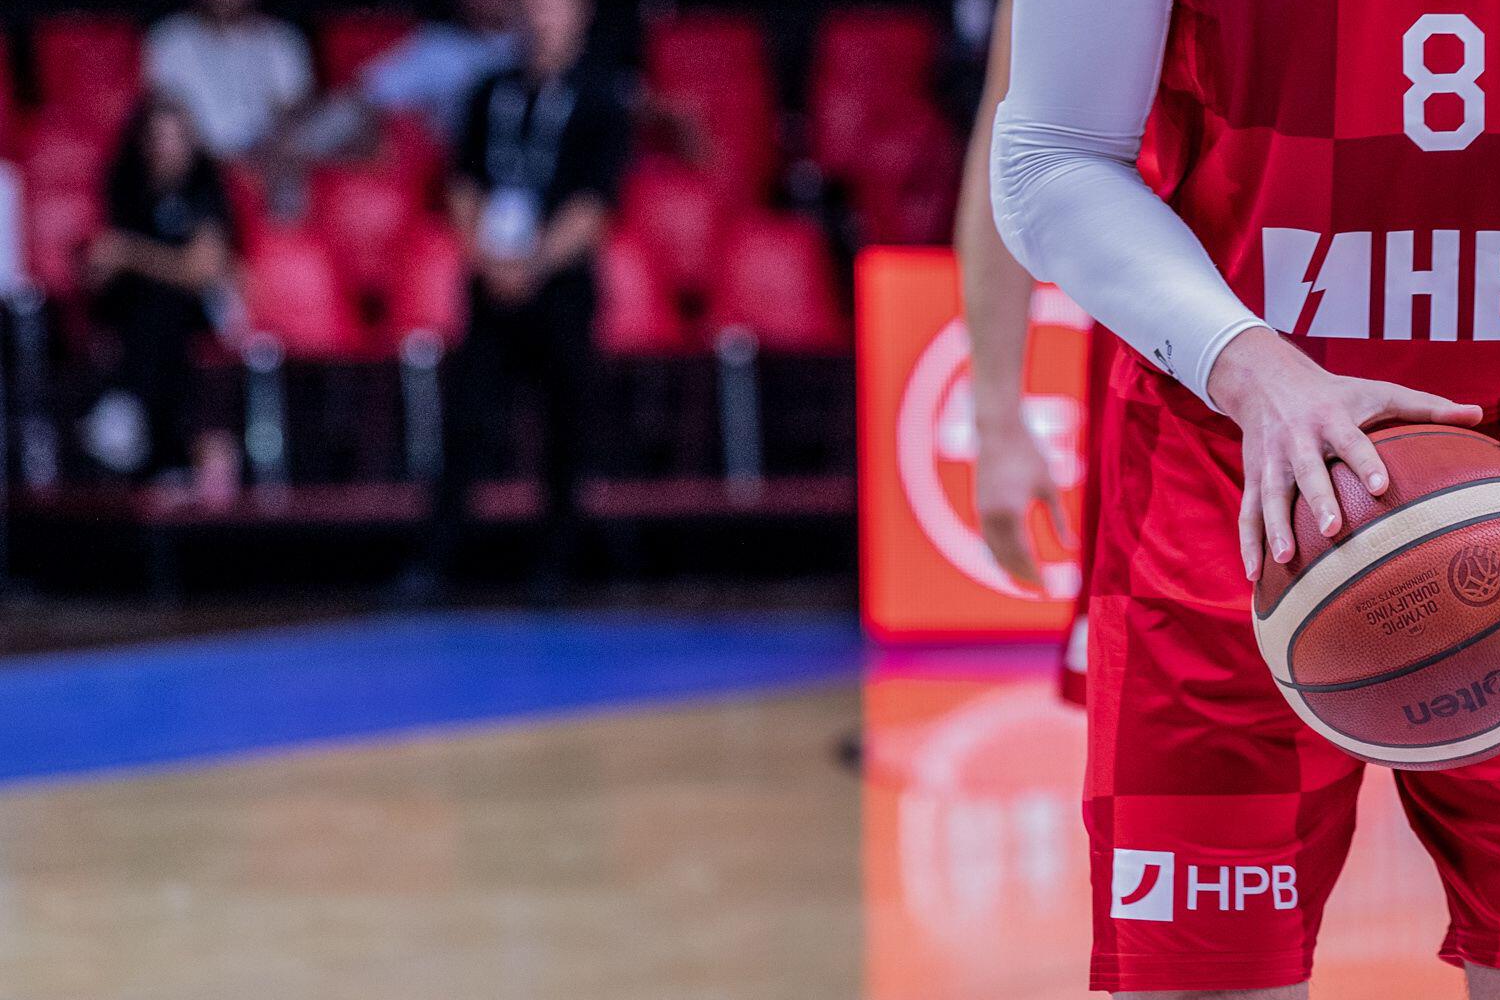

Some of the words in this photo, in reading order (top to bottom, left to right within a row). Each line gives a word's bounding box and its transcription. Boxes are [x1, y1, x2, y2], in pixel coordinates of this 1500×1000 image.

[1403, 13, 1486, 152] 8
[1378, 568, 1439, 601] TOURNAMENTS
[1356, 596, 1377, 613] 2024
[1367, 583, 1440, 625] QUALIFYING
[1384, 600, 1438, 635] OLYMPIC
[1187, 864, 1299, 911] HPB
